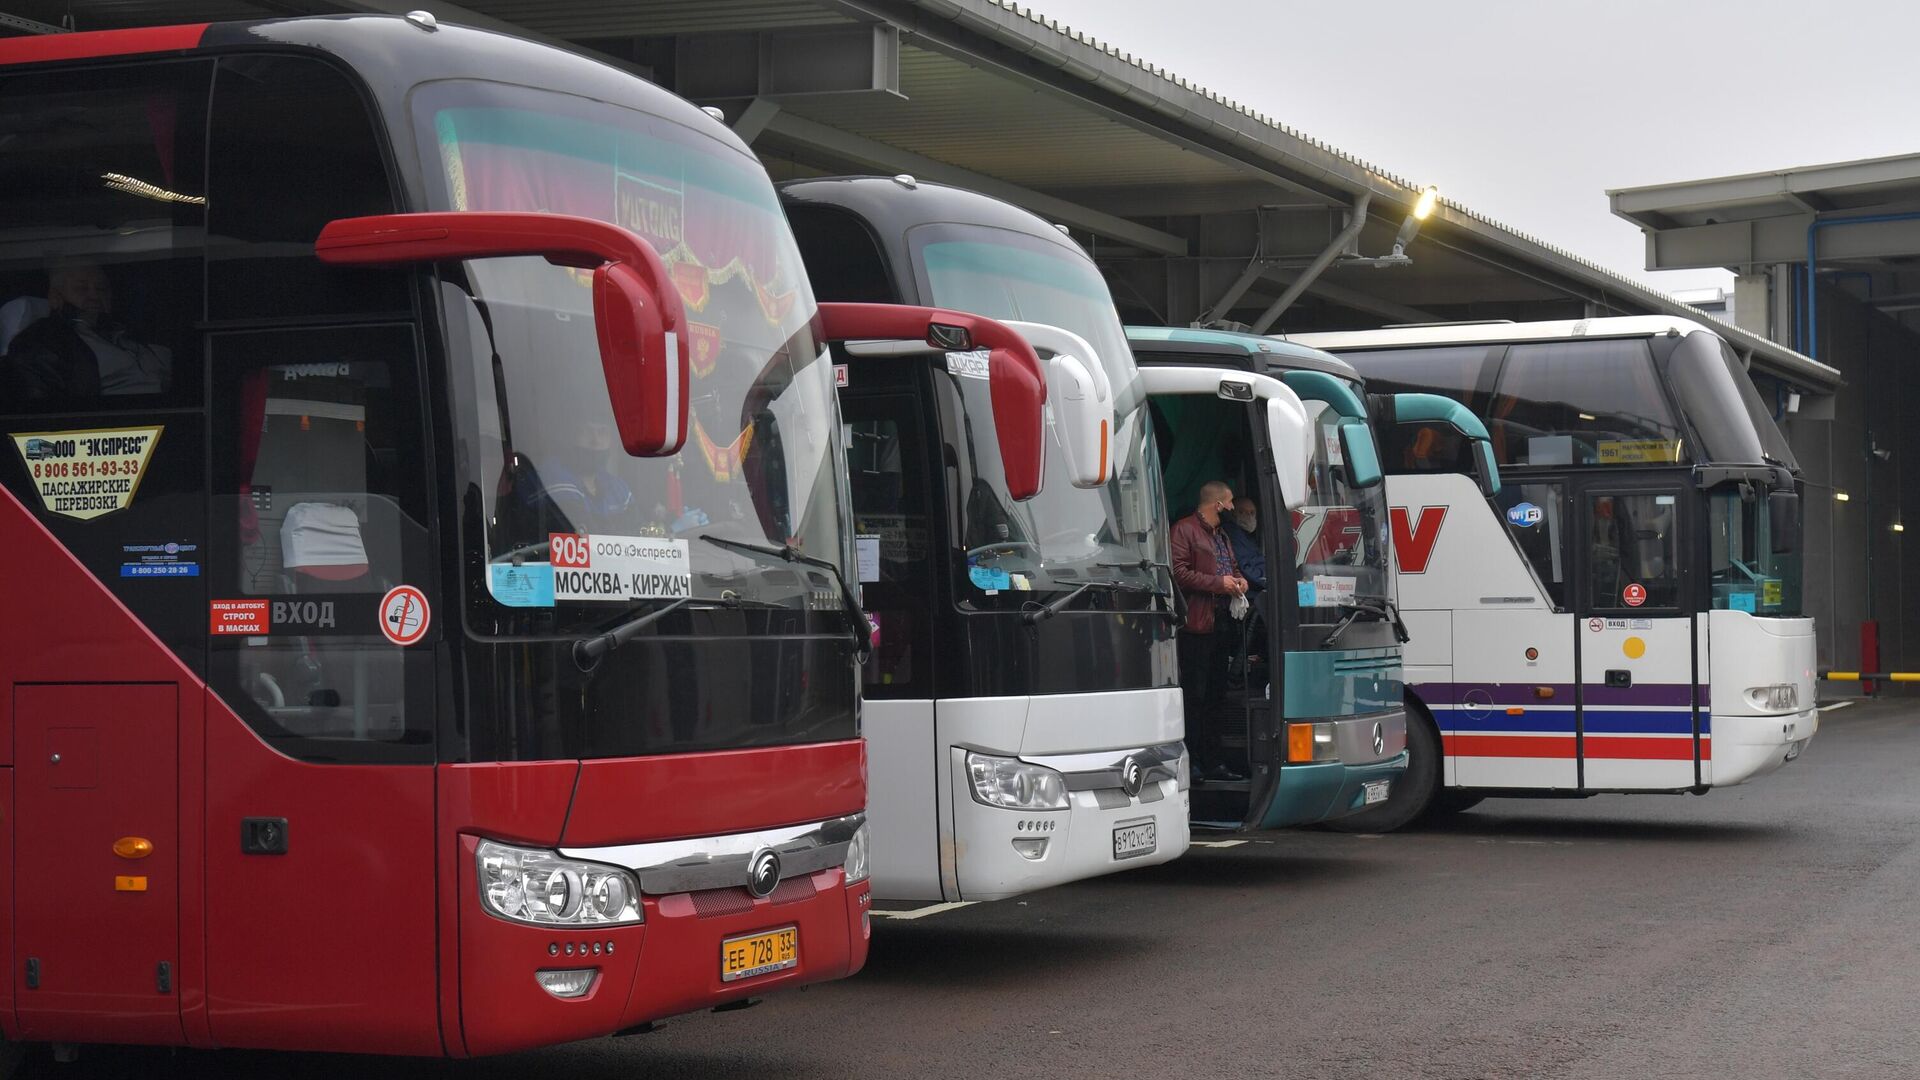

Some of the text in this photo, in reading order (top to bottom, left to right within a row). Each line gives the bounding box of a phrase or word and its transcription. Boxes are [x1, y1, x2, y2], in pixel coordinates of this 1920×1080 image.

[54, 440, 76, 458] ООО
[34, 460, 139, 478] 8 906 561-93-33
[42, 478, 130, 496] ПАССАЖИРСКИЕ
[55, 496, 118, 511] ПЕРЕВОЗКИ
[552, 536, 682, 564] 905 ООО «Экспресс»
[556, 572, 622, 594] МОСКВА
[632, 574, 690, 596] КИРЖАЧ
[272, 602, 335, 628] ВХОД
[226, 624, 260, 632] МАСКАХ
[750, 938, 772, 966] 728
[780, 932, 791, 952] 33
[744, 964, 779, 977] RUSSIA
